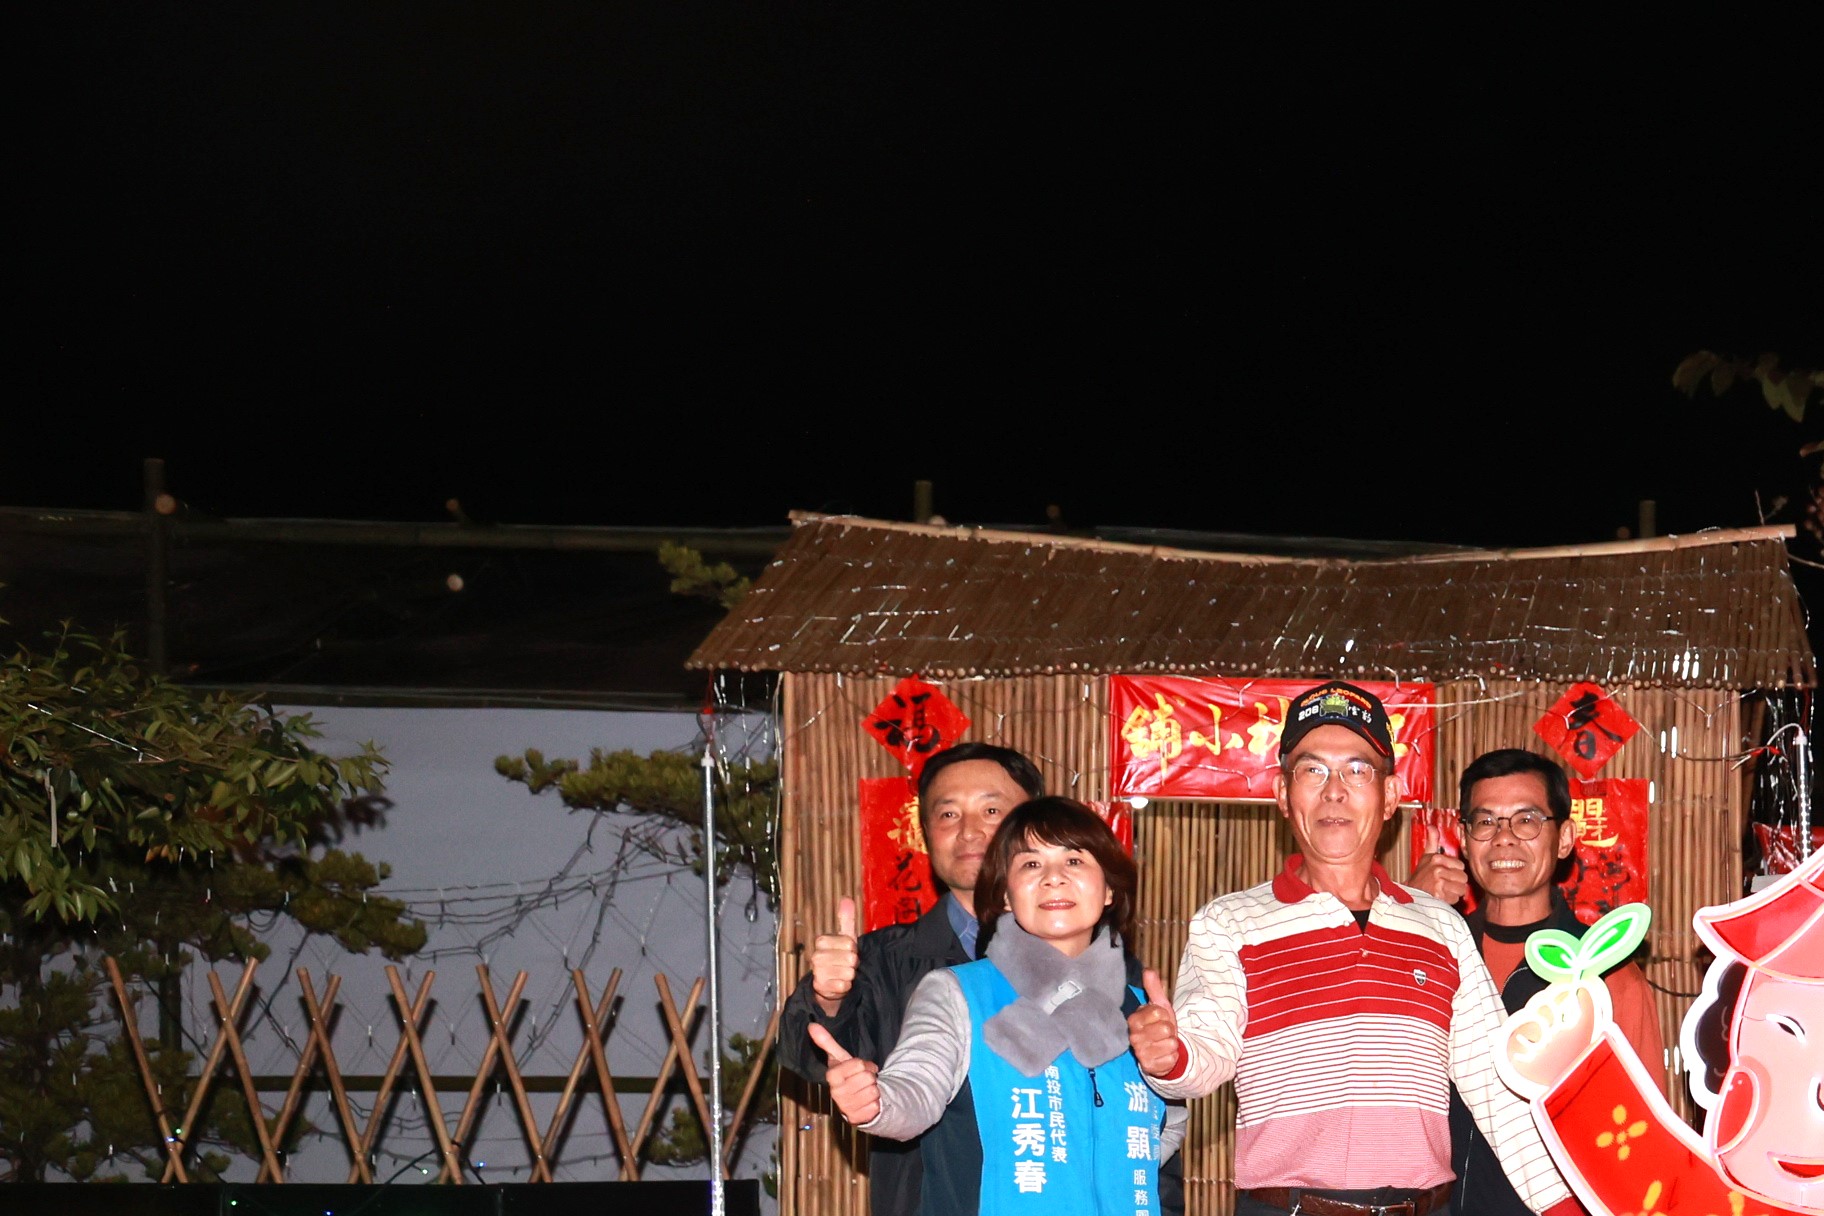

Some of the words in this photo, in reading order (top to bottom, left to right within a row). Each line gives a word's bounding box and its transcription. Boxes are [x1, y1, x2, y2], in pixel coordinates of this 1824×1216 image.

[1298, 705, 1319, 721] 208
[1570, 691, 1623, 760] 春
[1011, 1087, 1047, 1193] 江秀春
[1045, 1065, 1067, 1164] 南投市民代表
